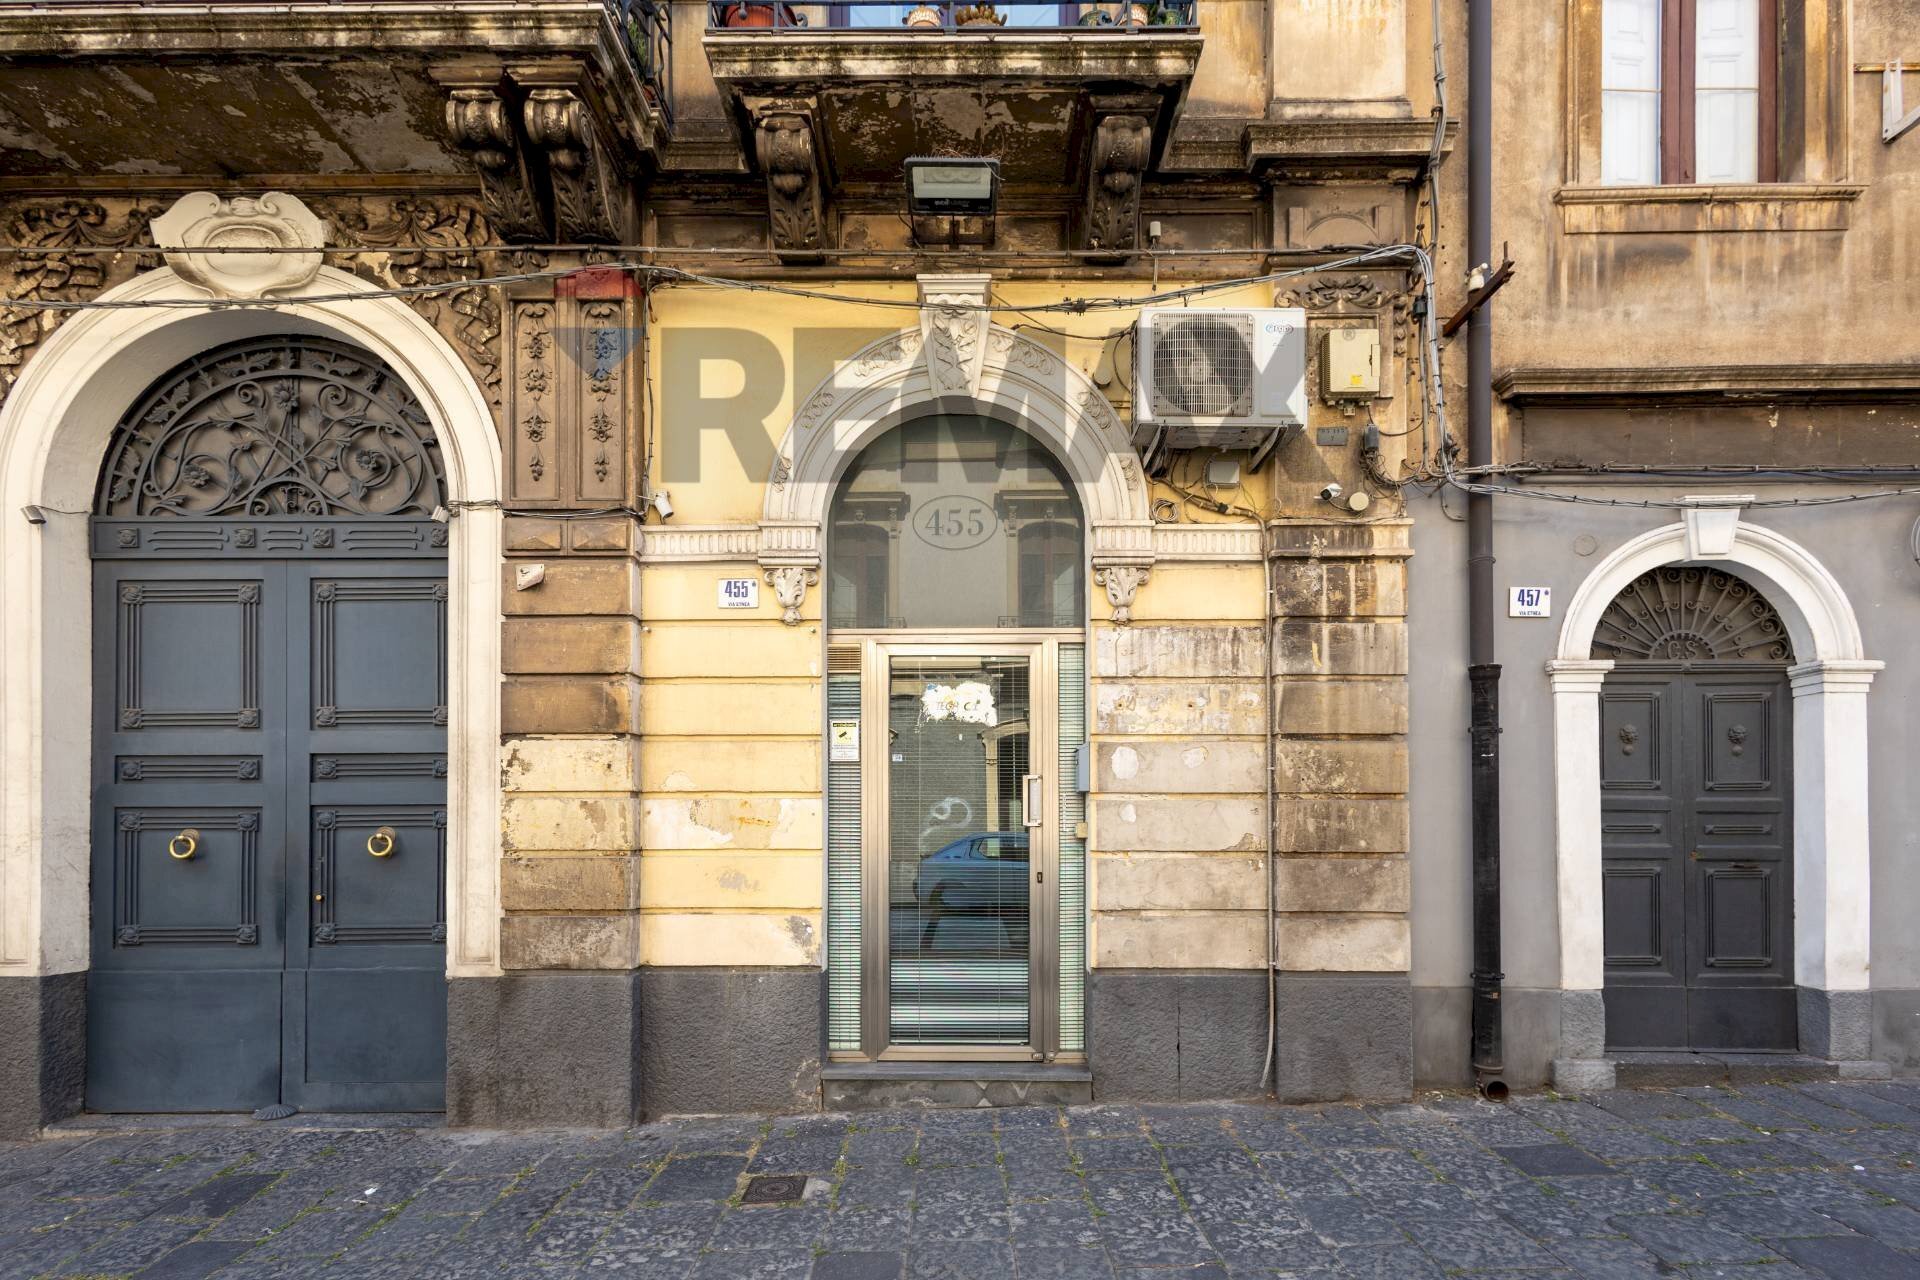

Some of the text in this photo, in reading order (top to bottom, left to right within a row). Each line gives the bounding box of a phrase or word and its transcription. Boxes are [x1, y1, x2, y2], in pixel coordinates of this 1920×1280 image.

[925, 508, 984, 536] 455
[725, 581, 749, 598] 455
[1517, 589, 1541, 606] 457
